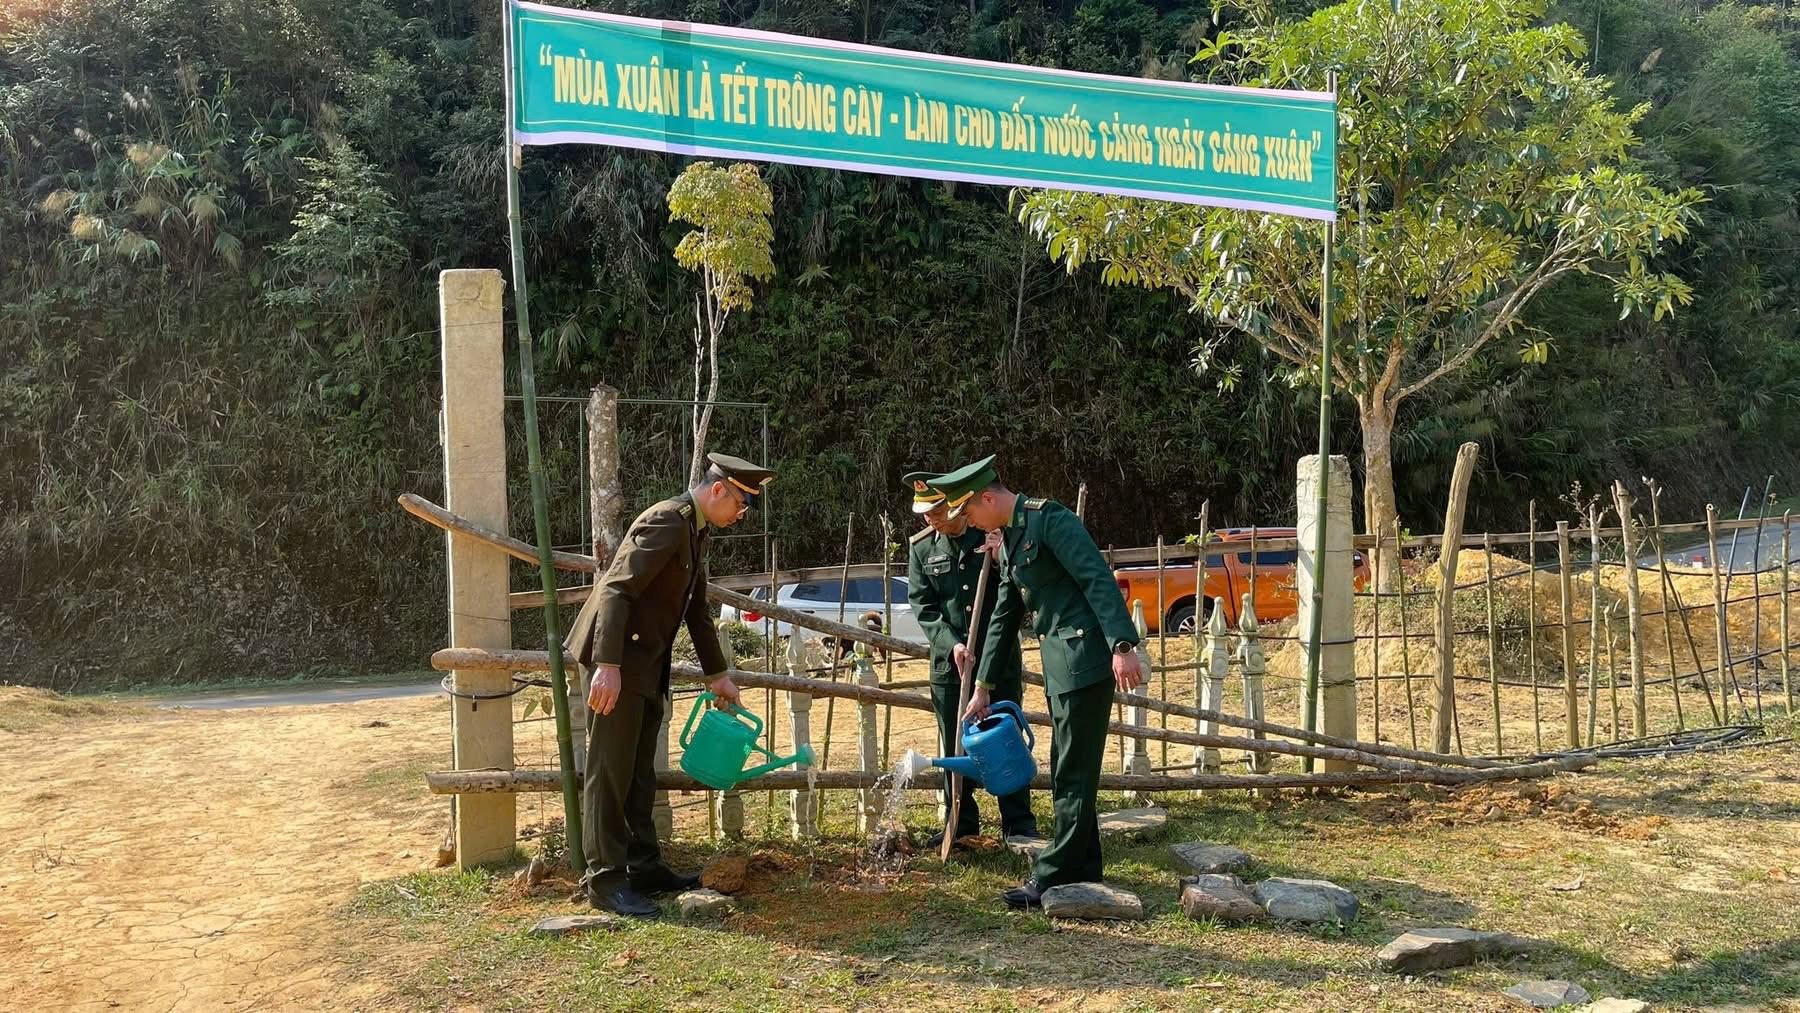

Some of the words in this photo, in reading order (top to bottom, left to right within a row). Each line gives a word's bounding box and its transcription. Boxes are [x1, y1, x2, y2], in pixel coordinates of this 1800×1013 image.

[616, 56, 680, 117] XUÂN
[687, 60, 715, 121] LÀ
[720, 61, 759, 125] TẾT
[763, 71, 836, 133] TRỒNG
[843, 84, 883, 137] CÂY
[889, 112, 899, 124] -
[904, 92, 949, 144] LÀM
[954, 104, 995, 149] CHO
[998, 96, 1036, 153] ĐẤT
[1040, 104, 1096, 160] NƯỚC
[1098, 112, 1153, 165] CÀNG
[1154, 118, 1205, 170] NGÀY
[1209, 122, 1260, 176] CÀNG
